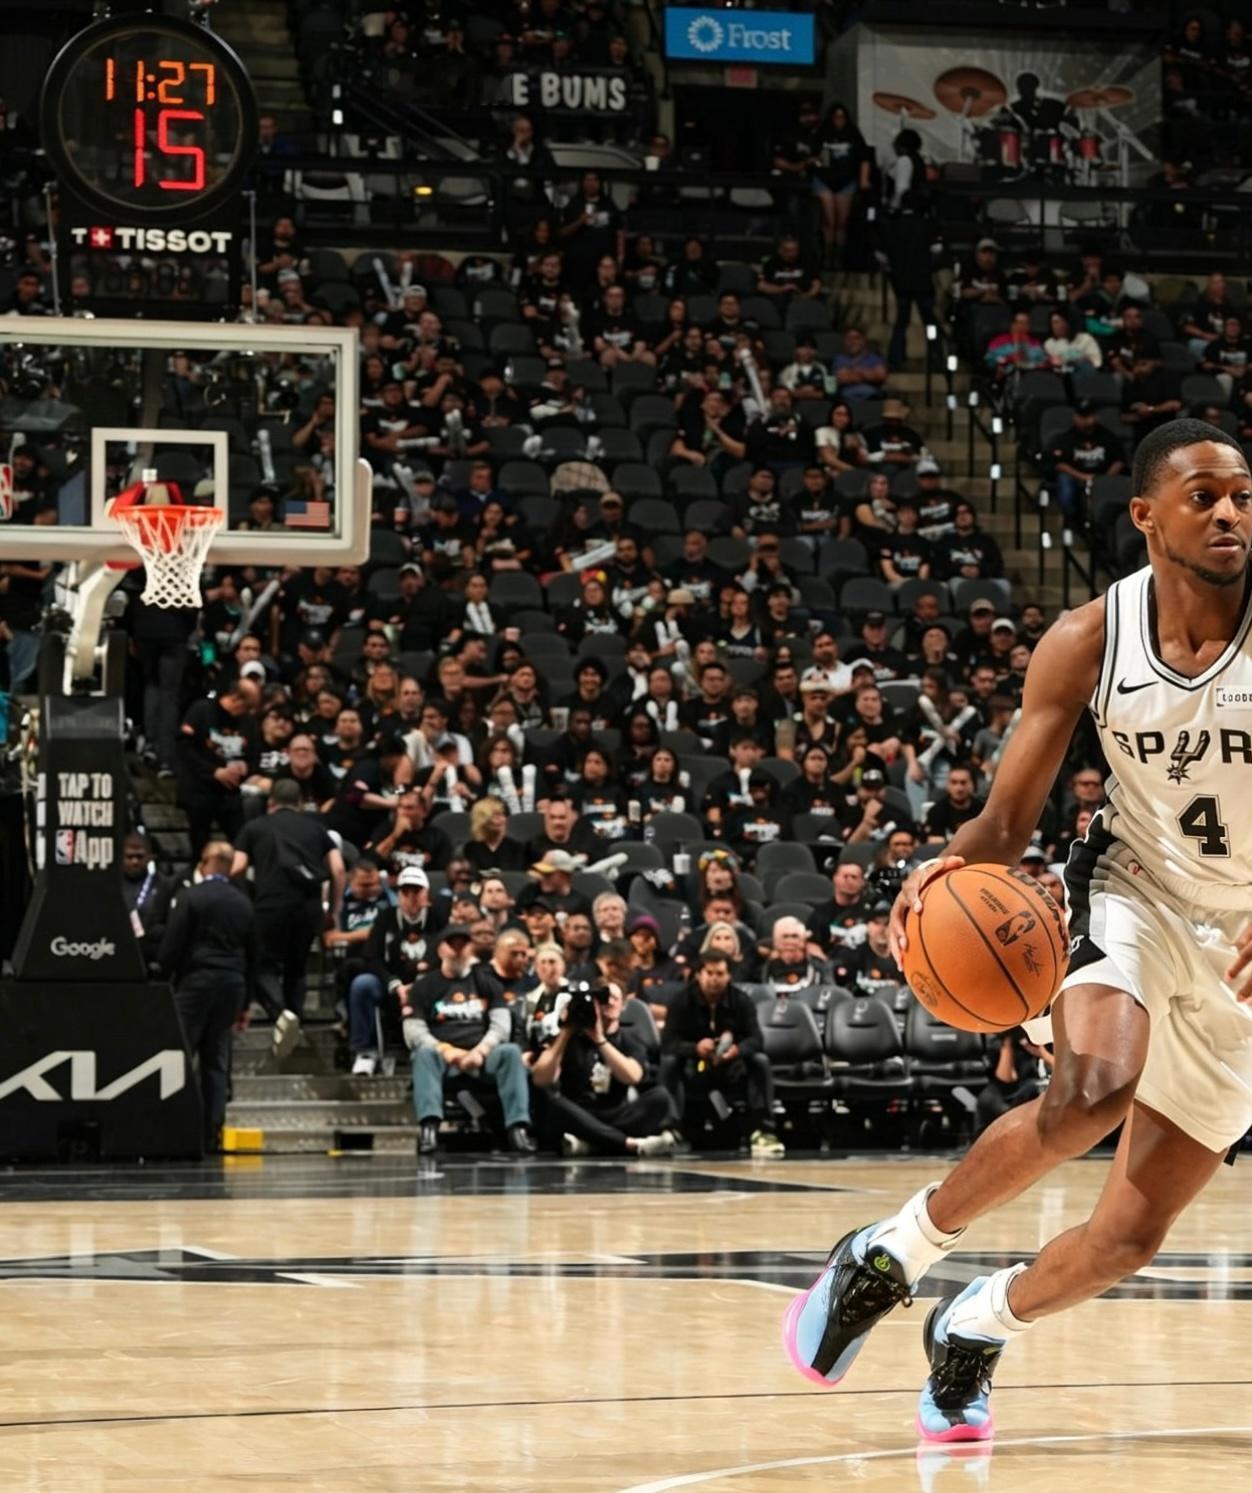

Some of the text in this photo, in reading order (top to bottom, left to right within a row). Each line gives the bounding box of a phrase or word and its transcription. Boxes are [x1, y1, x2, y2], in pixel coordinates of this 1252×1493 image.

[728, 23, 791, 50] Frost
[106, 58, 214, 105] 11:27
[541, 72, 626, 110] BUMS
[134, 108, 205, 190] 15
[115, 227, 232, 253] TISSOT
[58, 772, 113, 798] TAP TO
[58, 801, 113, 826] WATCH
[1176, 794, 1231, 858] 4
[74, 829, 113, 870] App
[50, 936, 115, 960] Google
